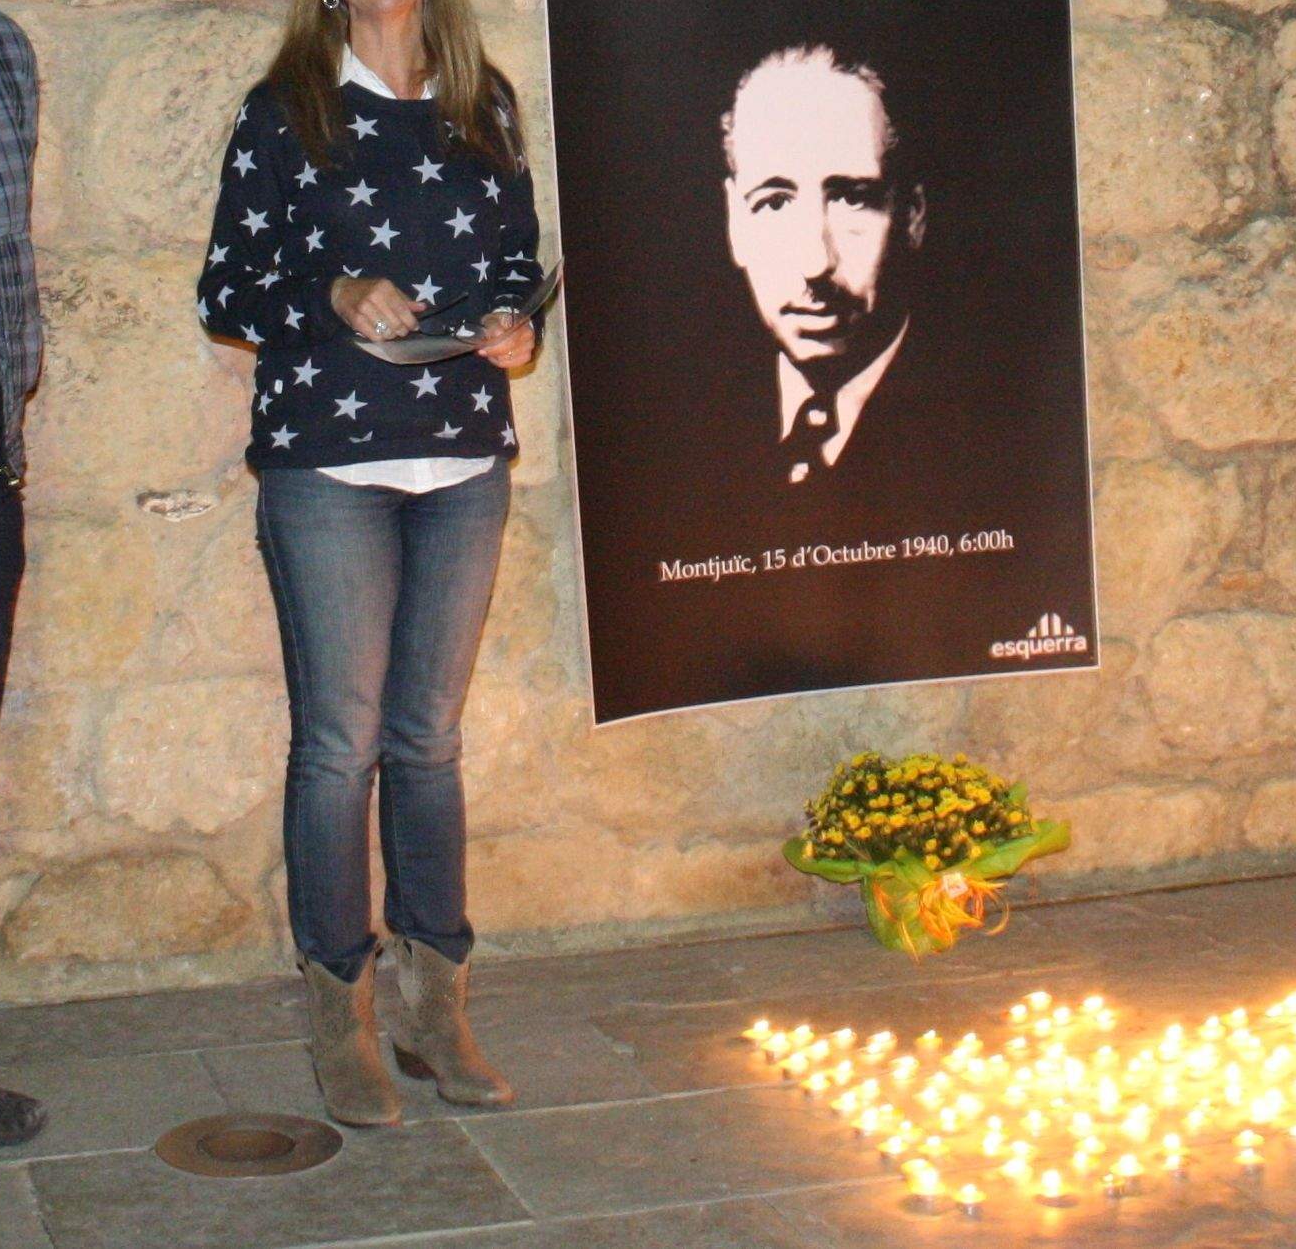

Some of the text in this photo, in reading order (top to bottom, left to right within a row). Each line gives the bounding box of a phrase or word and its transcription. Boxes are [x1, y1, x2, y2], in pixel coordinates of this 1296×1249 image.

[659, 528, 1014, 582] Montjuïc, 15 d'Octubre 1940, 6:00h
[990, 634, 1088, 660] esquerra
